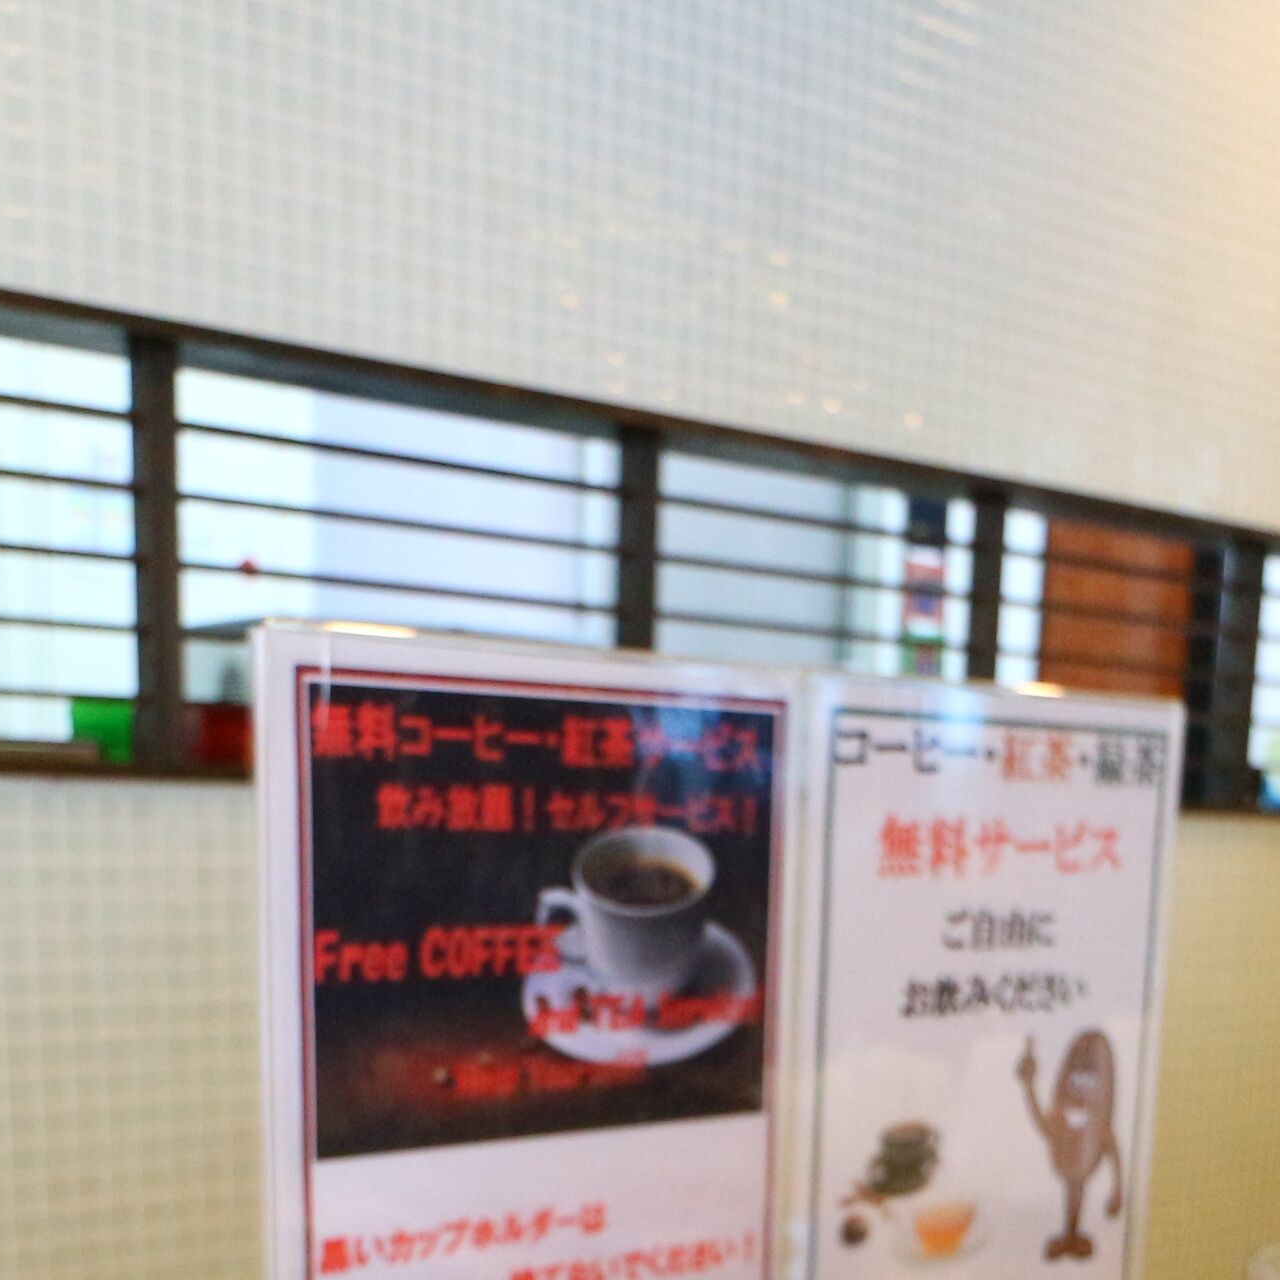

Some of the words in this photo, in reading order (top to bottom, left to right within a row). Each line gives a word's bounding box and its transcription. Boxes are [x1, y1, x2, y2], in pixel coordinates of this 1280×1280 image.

[878, 812, 1120, 878] 無料サービス
[313, 927, 408, 985] Free
[421, 920, 566, 980] COFFEE
[321, 1203, 606, 1274] 黒いカップホルダーは
